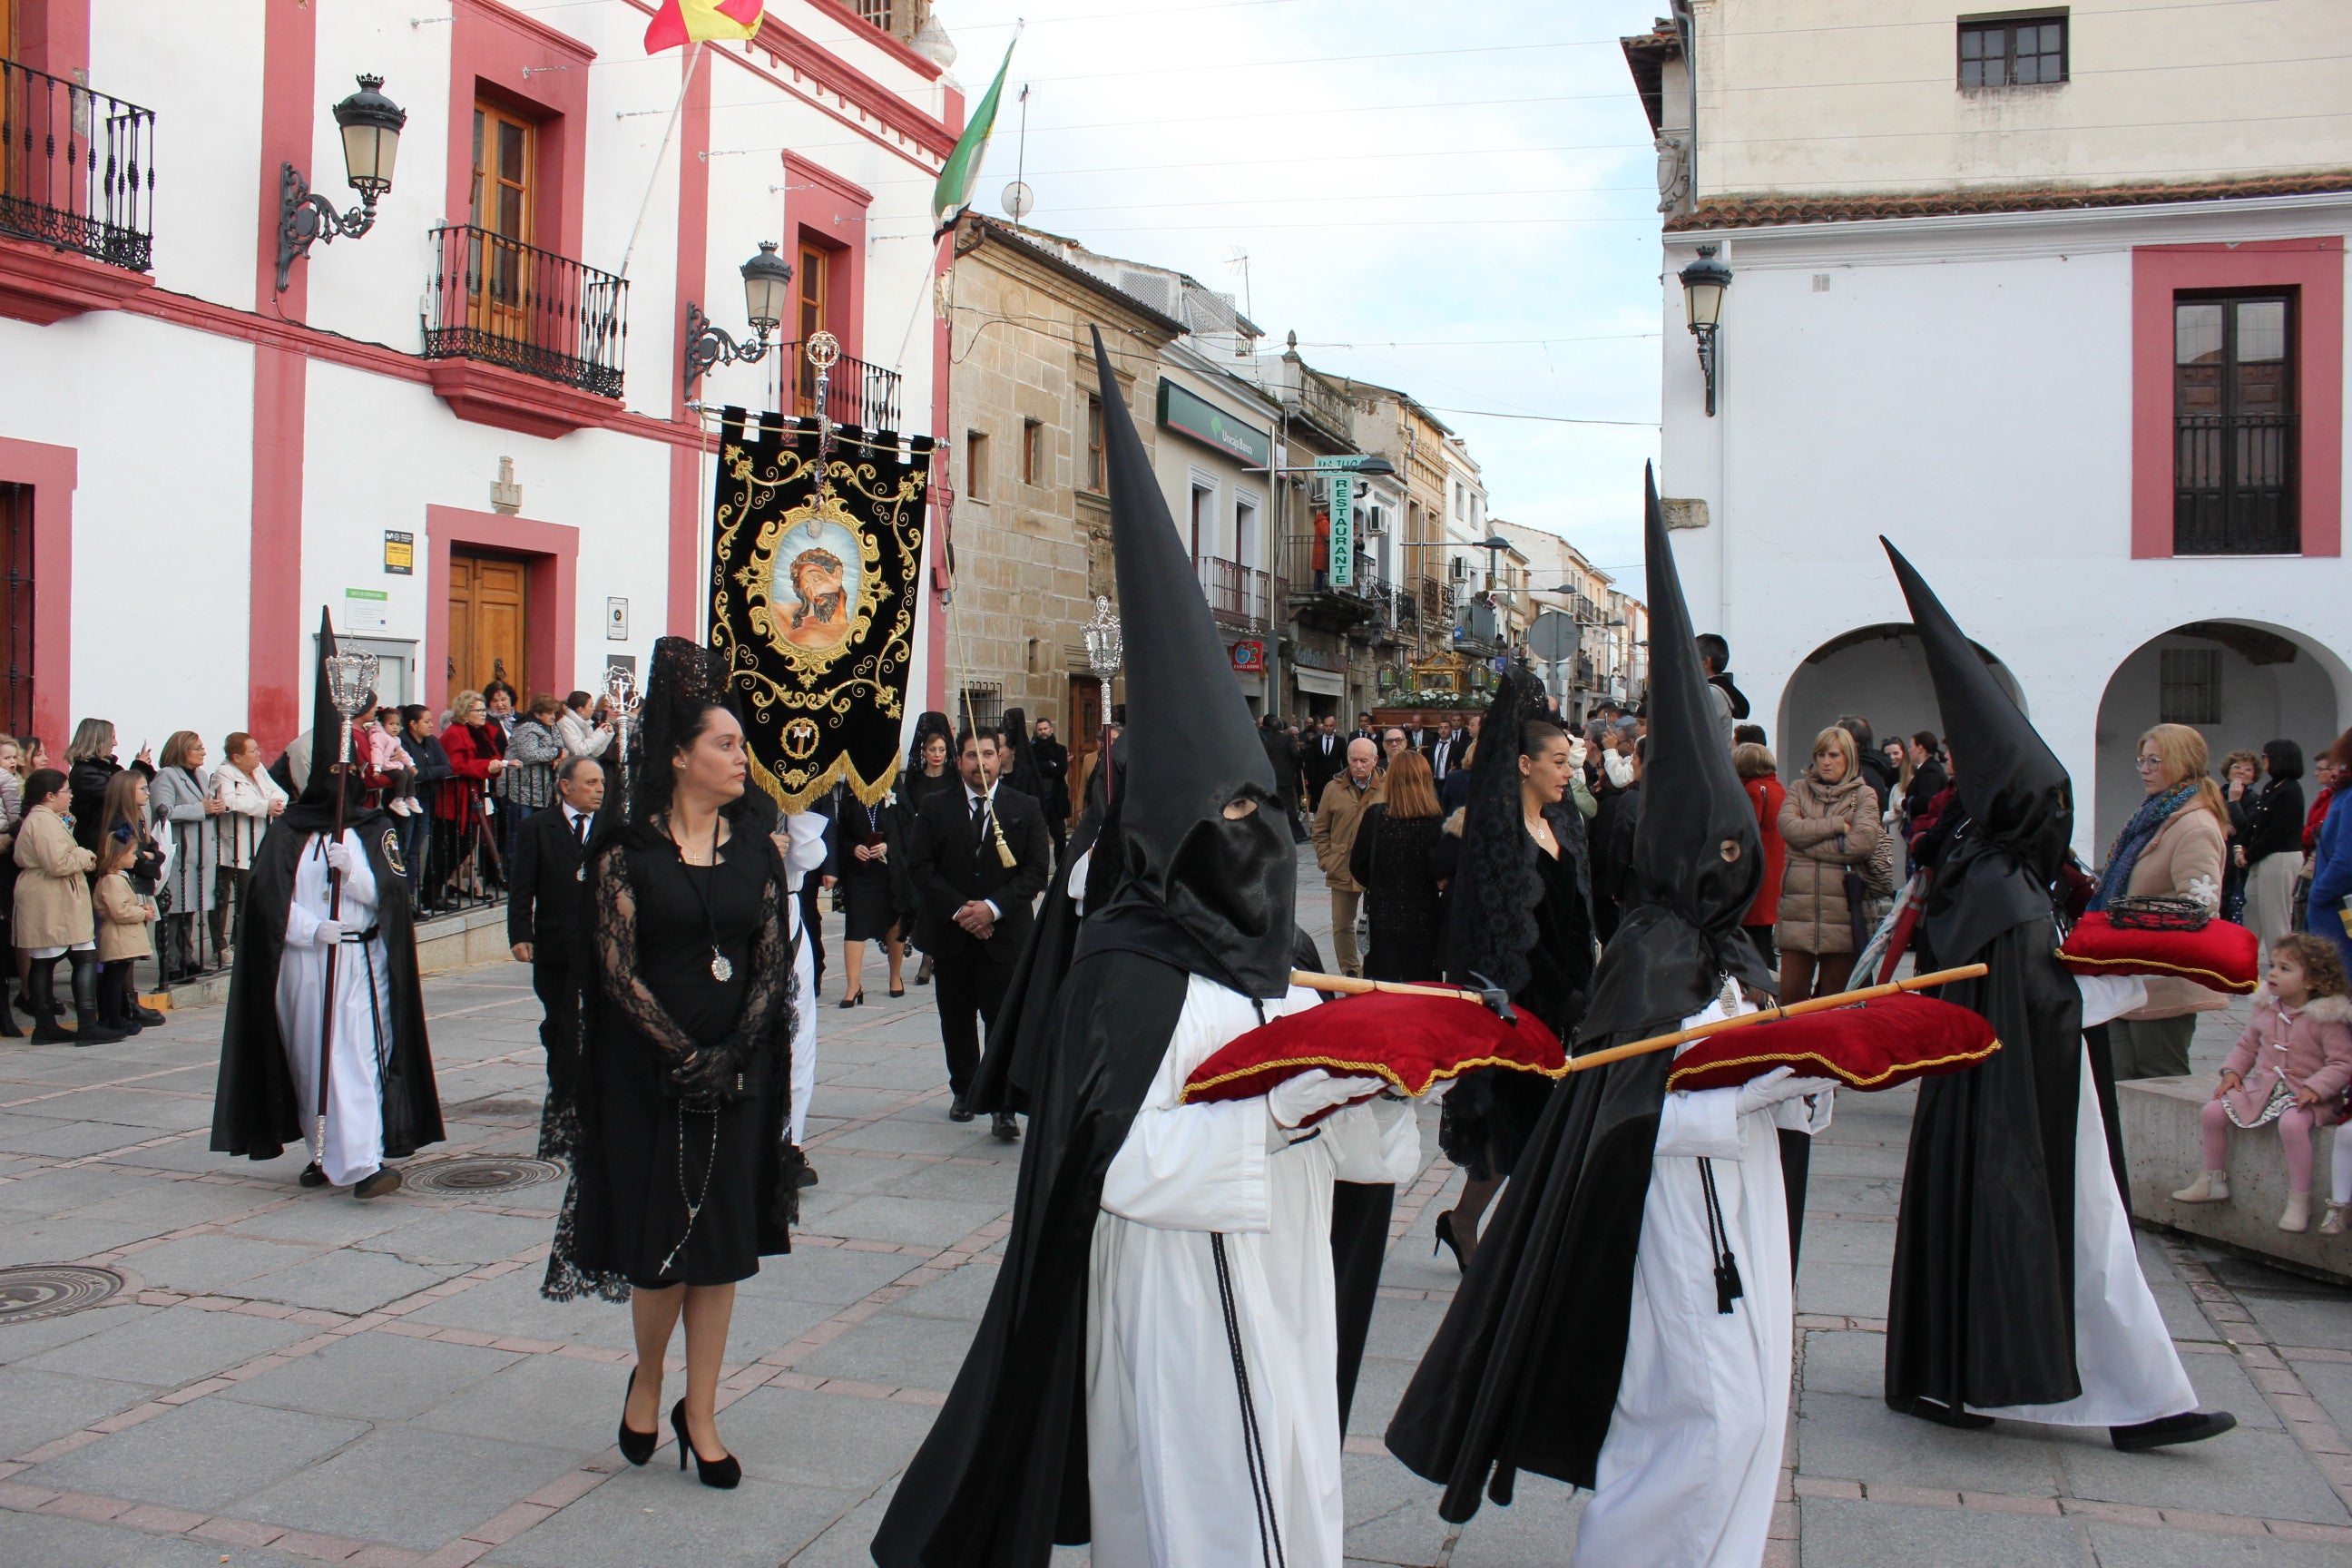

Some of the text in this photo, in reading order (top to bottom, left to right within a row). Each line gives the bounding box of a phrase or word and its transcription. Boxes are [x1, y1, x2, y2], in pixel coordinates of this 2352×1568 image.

[1221, 428, 1253, 456] Unicaja Banco
[1335, 479, 1348, 584] RESTAURANTE
